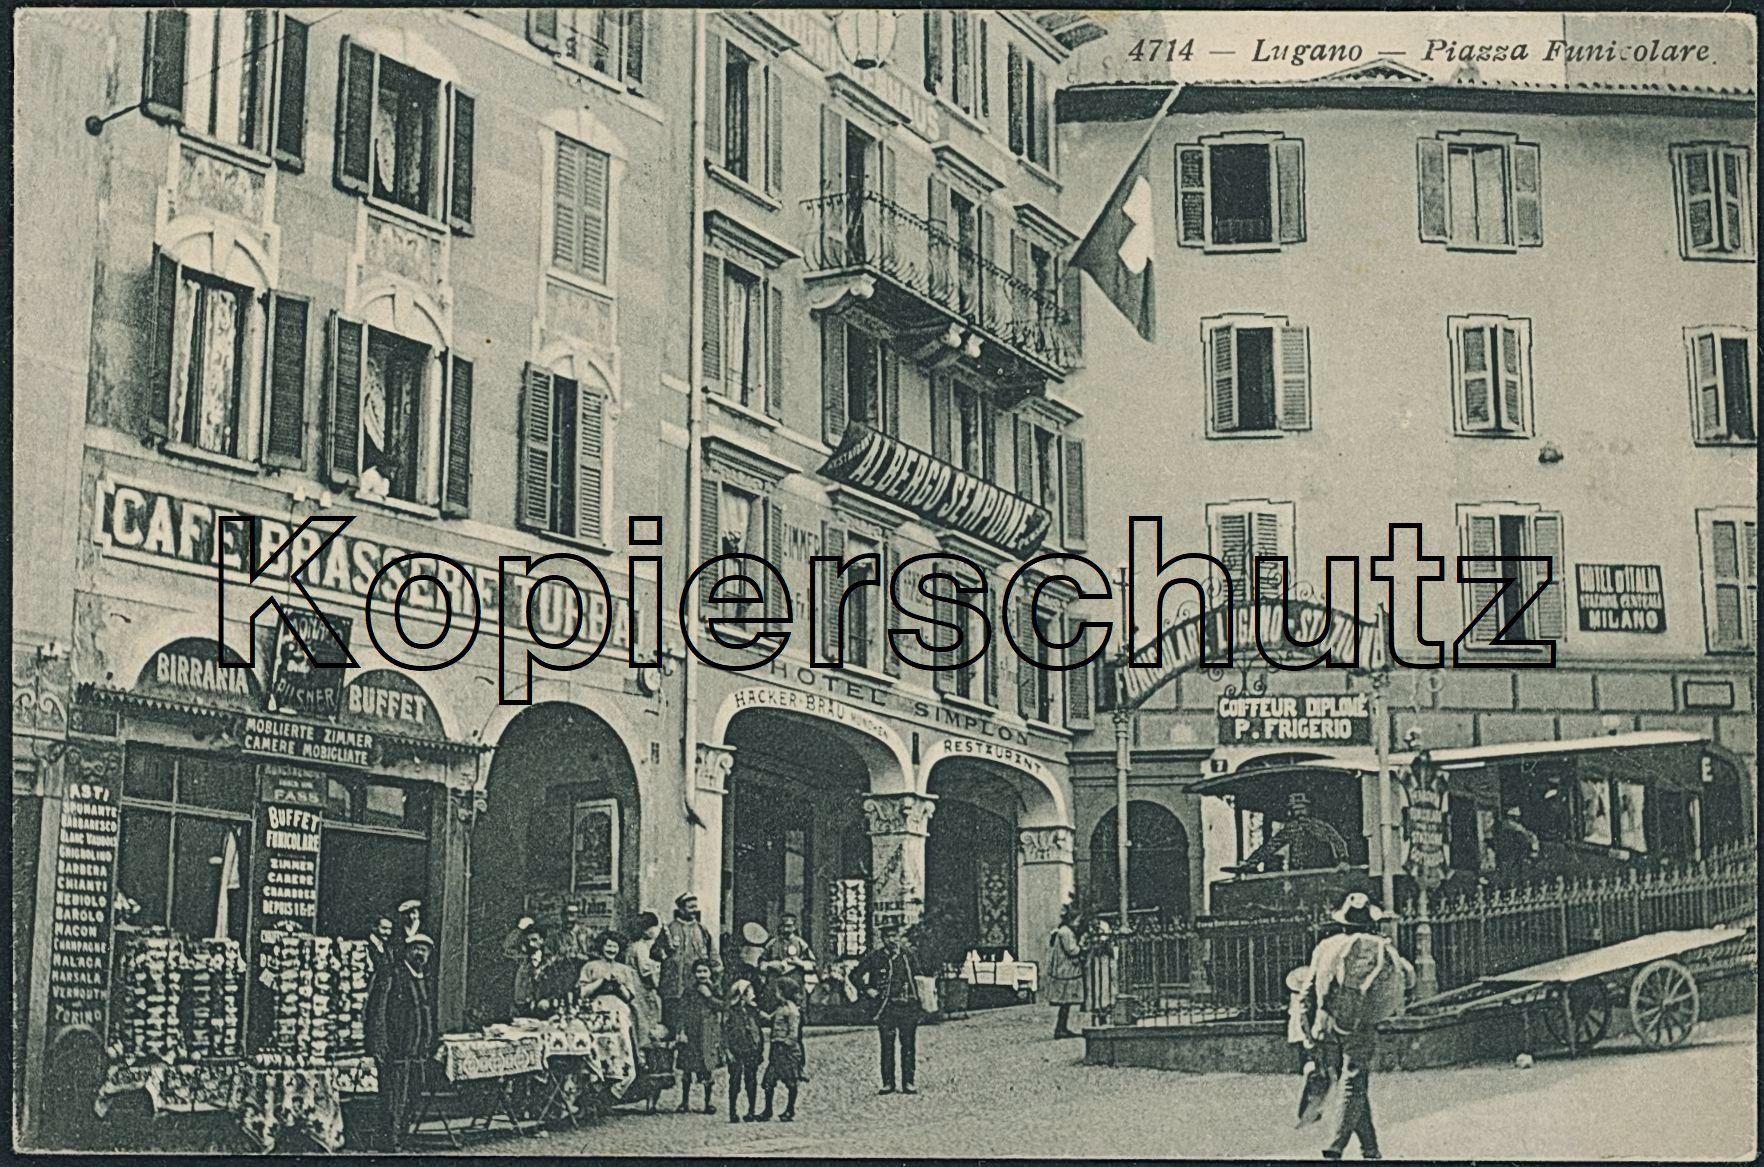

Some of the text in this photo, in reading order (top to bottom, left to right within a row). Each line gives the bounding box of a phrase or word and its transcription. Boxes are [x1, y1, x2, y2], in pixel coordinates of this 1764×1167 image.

[849, 432, 951, 511] ALBERGO
[936, 471, 1035, 549] SEMPIONE
[260, 519, 500, 618] BRASSERIE
[1588, 609, 1659, 630] MILANO
[349, 684, 427, 723] BUFFET
[769, 658, 1028, 746] HOTEL SIMPLON
[323, 728, 373, 749] ZIMMER
[1263, 718, 1352, 739] FRIGERIO
[244, 735, 296, 755] CAMERE
[943, 738, 1042, 774] RESTAURANT
[69, 783, 110, 802] ASTI
[268, 806, 321, 833] BUFFET
[57, 876, 108, 892] CHIANTI
[55, 905, 105, 923] BAROLO
[54, 922, 98, 938] MACON
[52, 970, 102, 985] MARSALA
